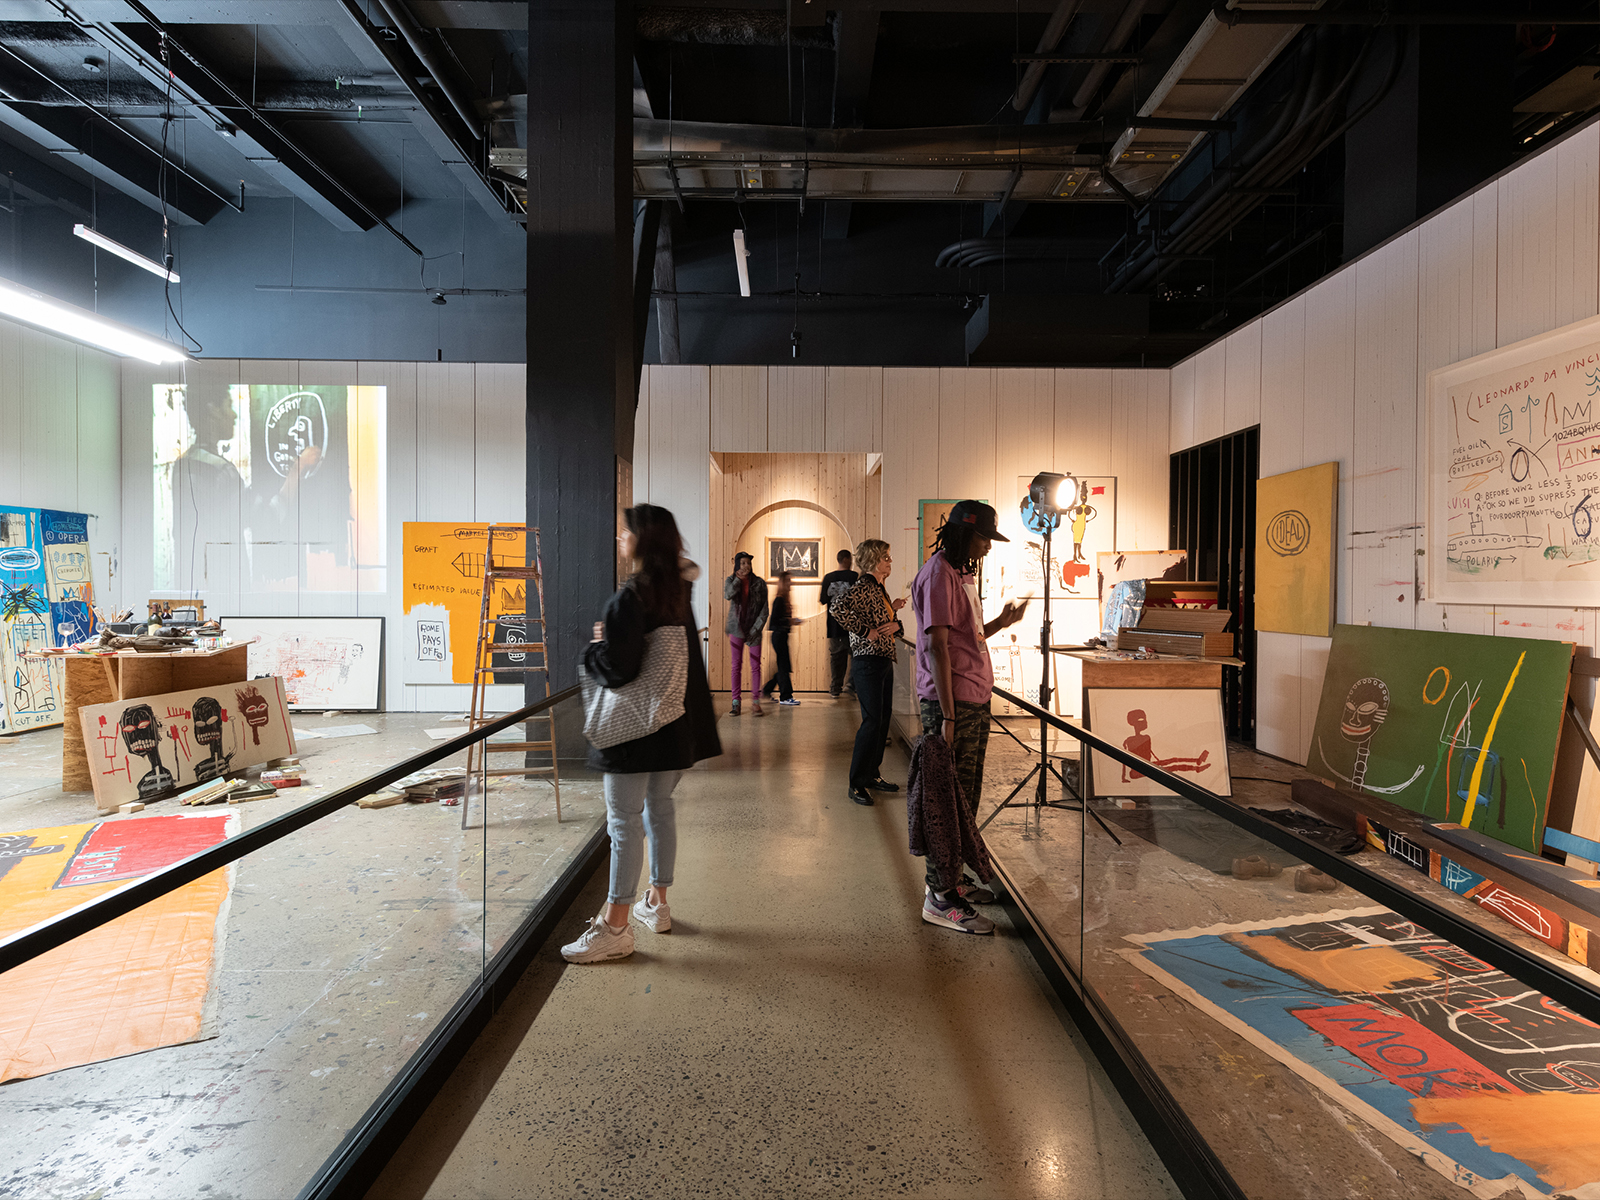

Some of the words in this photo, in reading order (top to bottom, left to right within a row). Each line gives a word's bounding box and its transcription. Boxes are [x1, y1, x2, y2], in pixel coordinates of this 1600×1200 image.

[1477, 376, 1535, 409] LEONARDO
[1543, 369, 1557, 383] DA
[1565, 353, 1600, 374] VINCI
[268, 397, 302, 429] LIBERTY
[1452, 459, 1485, 475] BOTTLED
[1486, 454, 1499, 464] GAS
[1485, 488, 1510, 501] BEFORE
[1512, 483, 1533, 493] WW2
[1538, 478, 1560, 488] LESS
[1498, 499, 1507, 508] SO
[1509, 497, 1520, 506] WE
[1523, 495, 1536, 504] DID
[1538, 489, 1576, 502] SUPRESS
[1581, 486, 1600, 497] THE
[58, 532, 86, 543] OPERA
[1276, 516, 1303, 546] IDEAL
[414, 545, 439, 554] GRAFT
[413, 583, 455, 593] ESTIMATED
[460, 588, 481, 597] VALUE
[420, 624, 440, 633] ROME
[422, 634, 442, 646] PAYS
[15, 716, 31, 726] CUT
